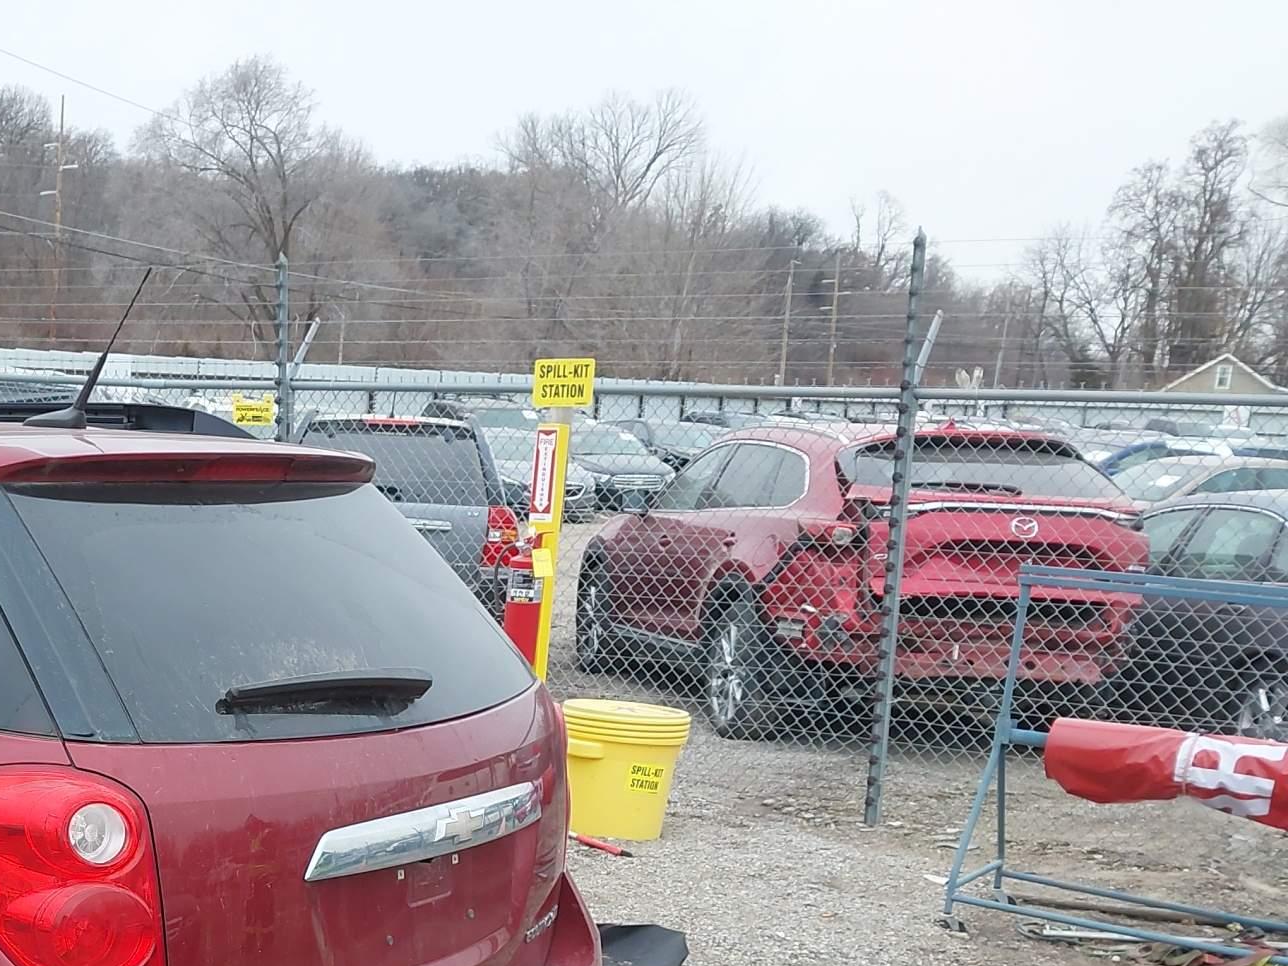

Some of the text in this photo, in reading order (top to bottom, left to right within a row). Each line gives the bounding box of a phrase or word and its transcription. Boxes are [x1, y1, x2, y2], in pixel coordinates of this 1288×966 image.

[539, 364, 590, 378] SPILL-KIT
[541, 383, 584, 398] STATION
[631, 765, 664, 777] SPILL-KIT
[630, 778, 659, 790] STATION
